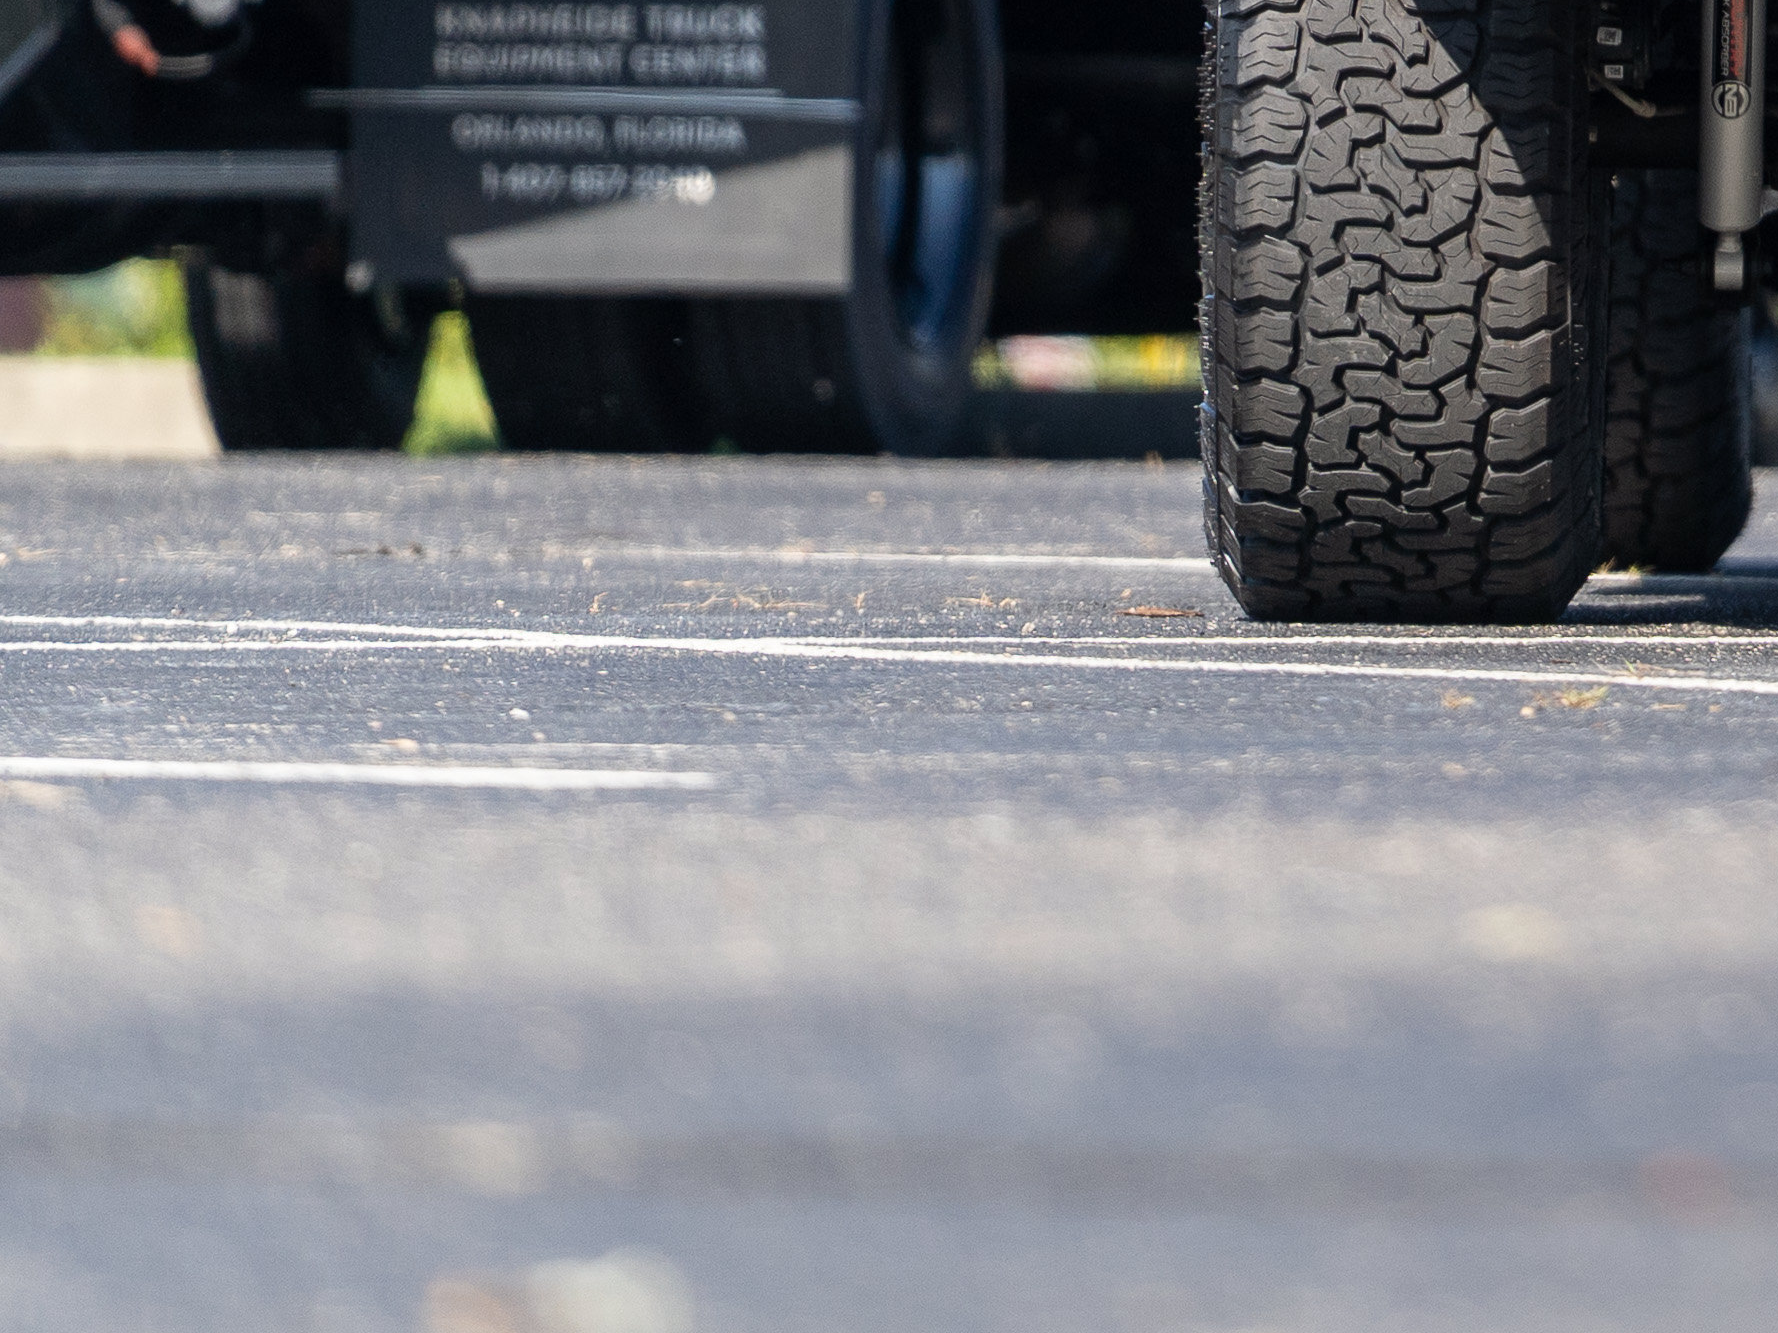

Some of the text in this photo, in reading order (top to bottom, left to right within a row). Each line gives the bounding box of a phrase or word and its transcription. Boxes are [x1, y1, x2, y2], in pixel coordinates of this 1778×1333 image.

[645, 4, 766, 38] TRUCK
[433, 43, 767, 79] EQUIPMENT CENTER
[1720, 11, 1730, 76] ABSORBER
